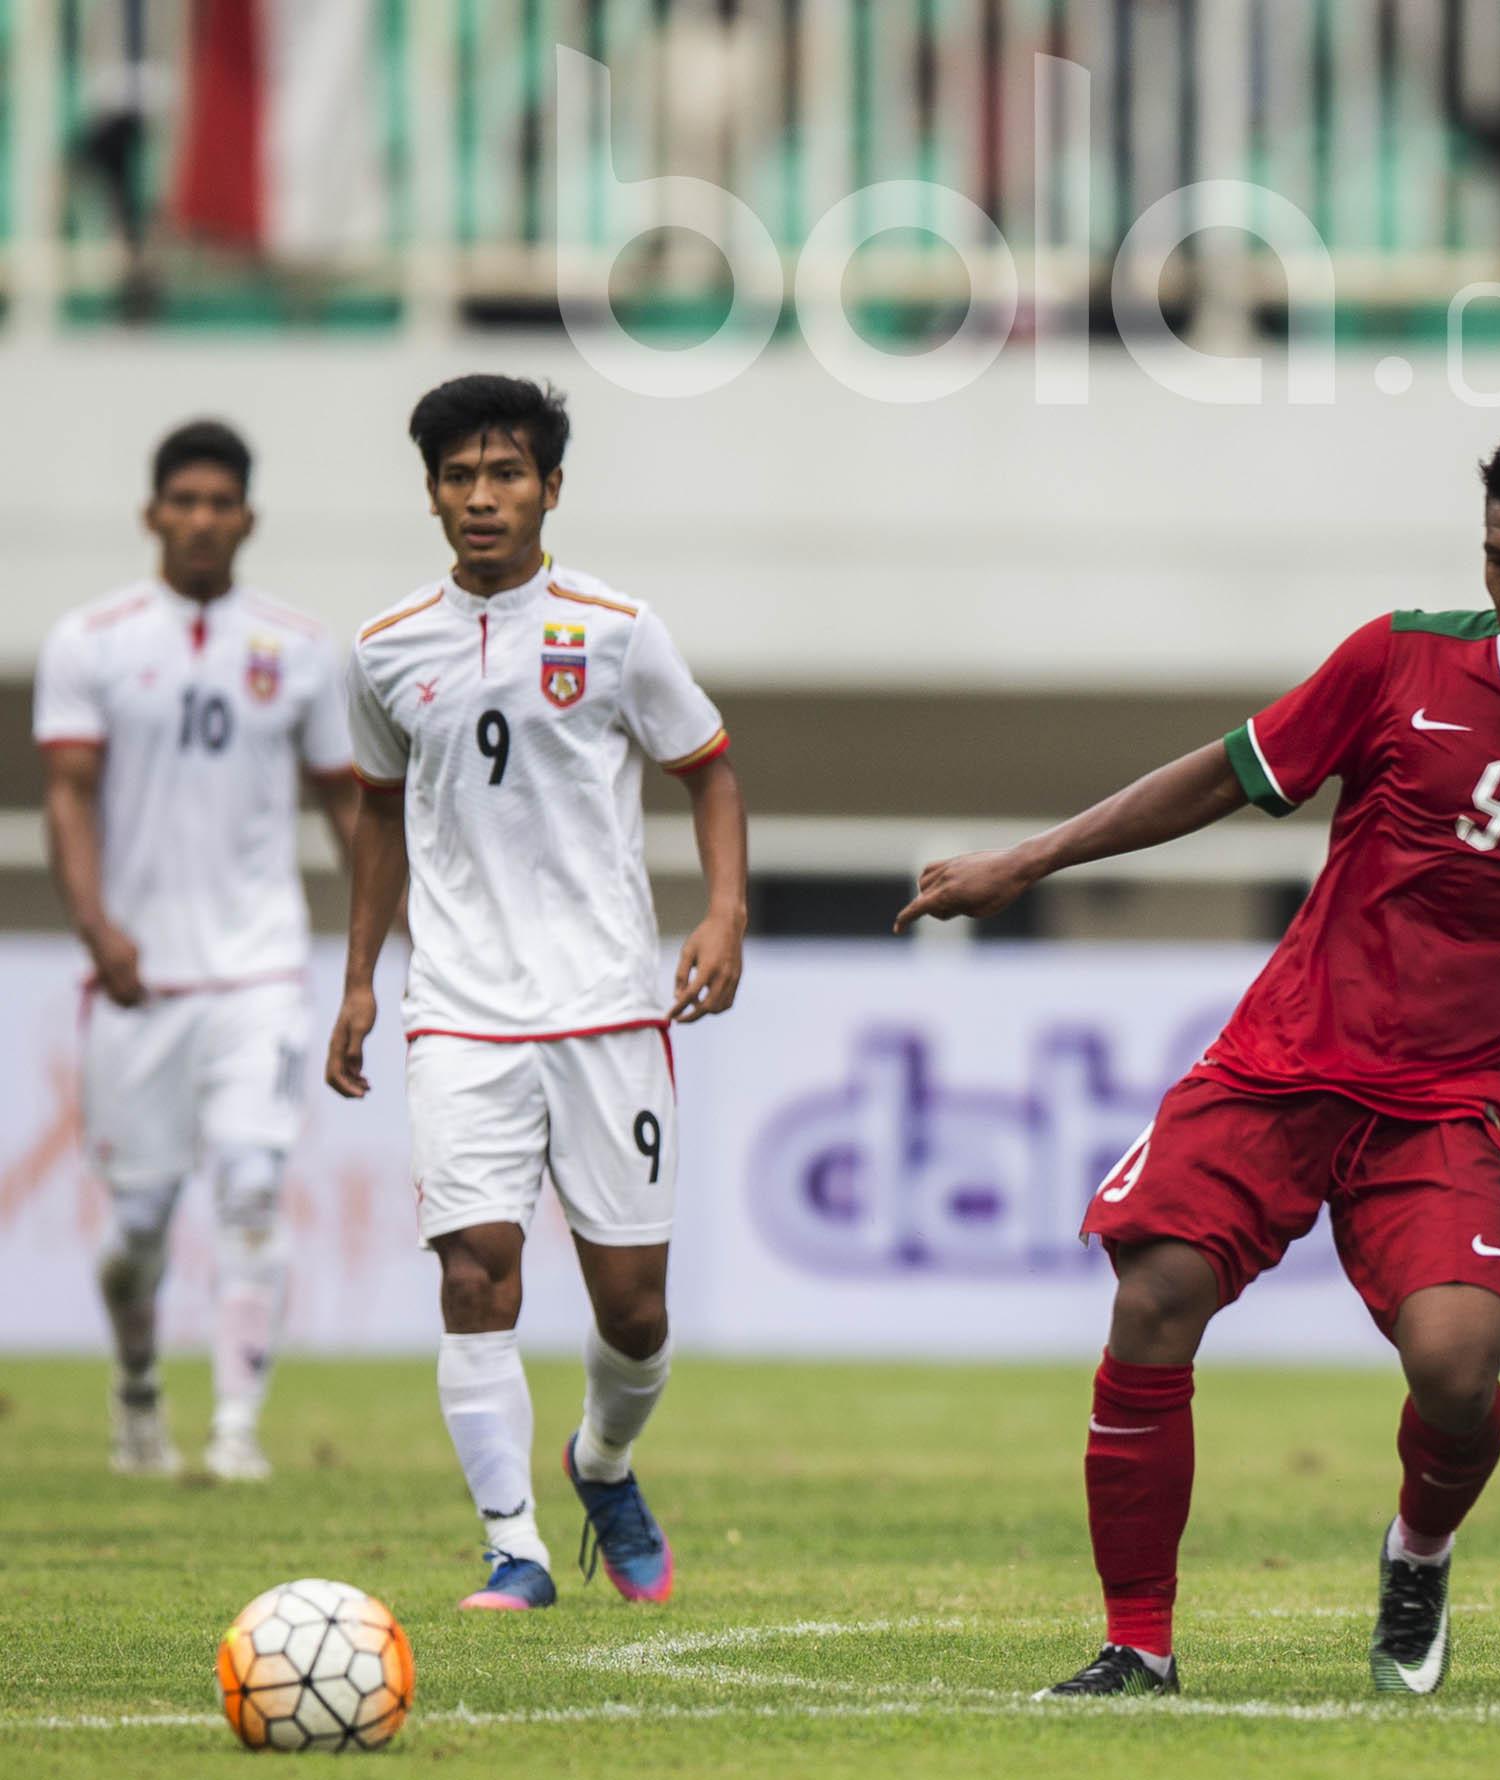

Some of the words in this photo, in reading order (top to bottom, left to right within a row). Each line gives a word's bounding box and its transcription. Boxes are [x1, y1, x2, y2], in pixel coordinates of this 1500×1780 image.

[178, 683, 234, 756] 10
[476, 709, 510, 786] 9
[634, 1110, 660, 1185] 9
